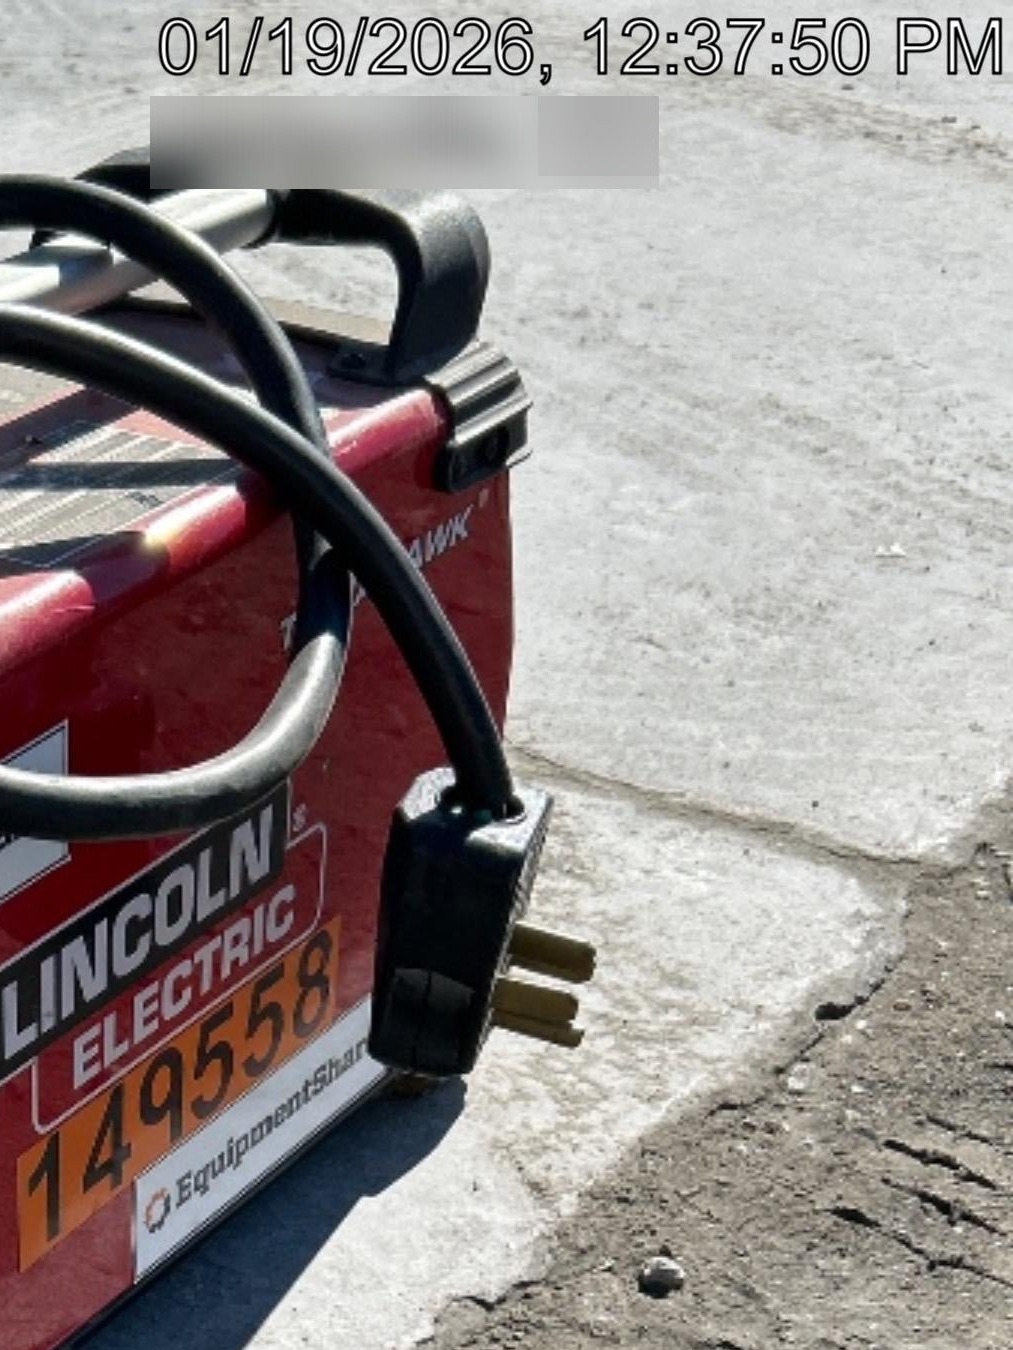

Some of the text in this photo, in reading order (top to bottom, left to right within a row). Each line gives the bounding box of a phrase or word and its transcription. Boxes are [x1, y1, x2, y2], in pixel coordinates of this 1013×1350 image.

[1, 804, 274, 1060] LINCOLN
[73, 884, 297, 1090] ELECTRIC
[27, 928, 334, 1243] 149558
[175, 1036, 368, 1209] EquipmentShar
